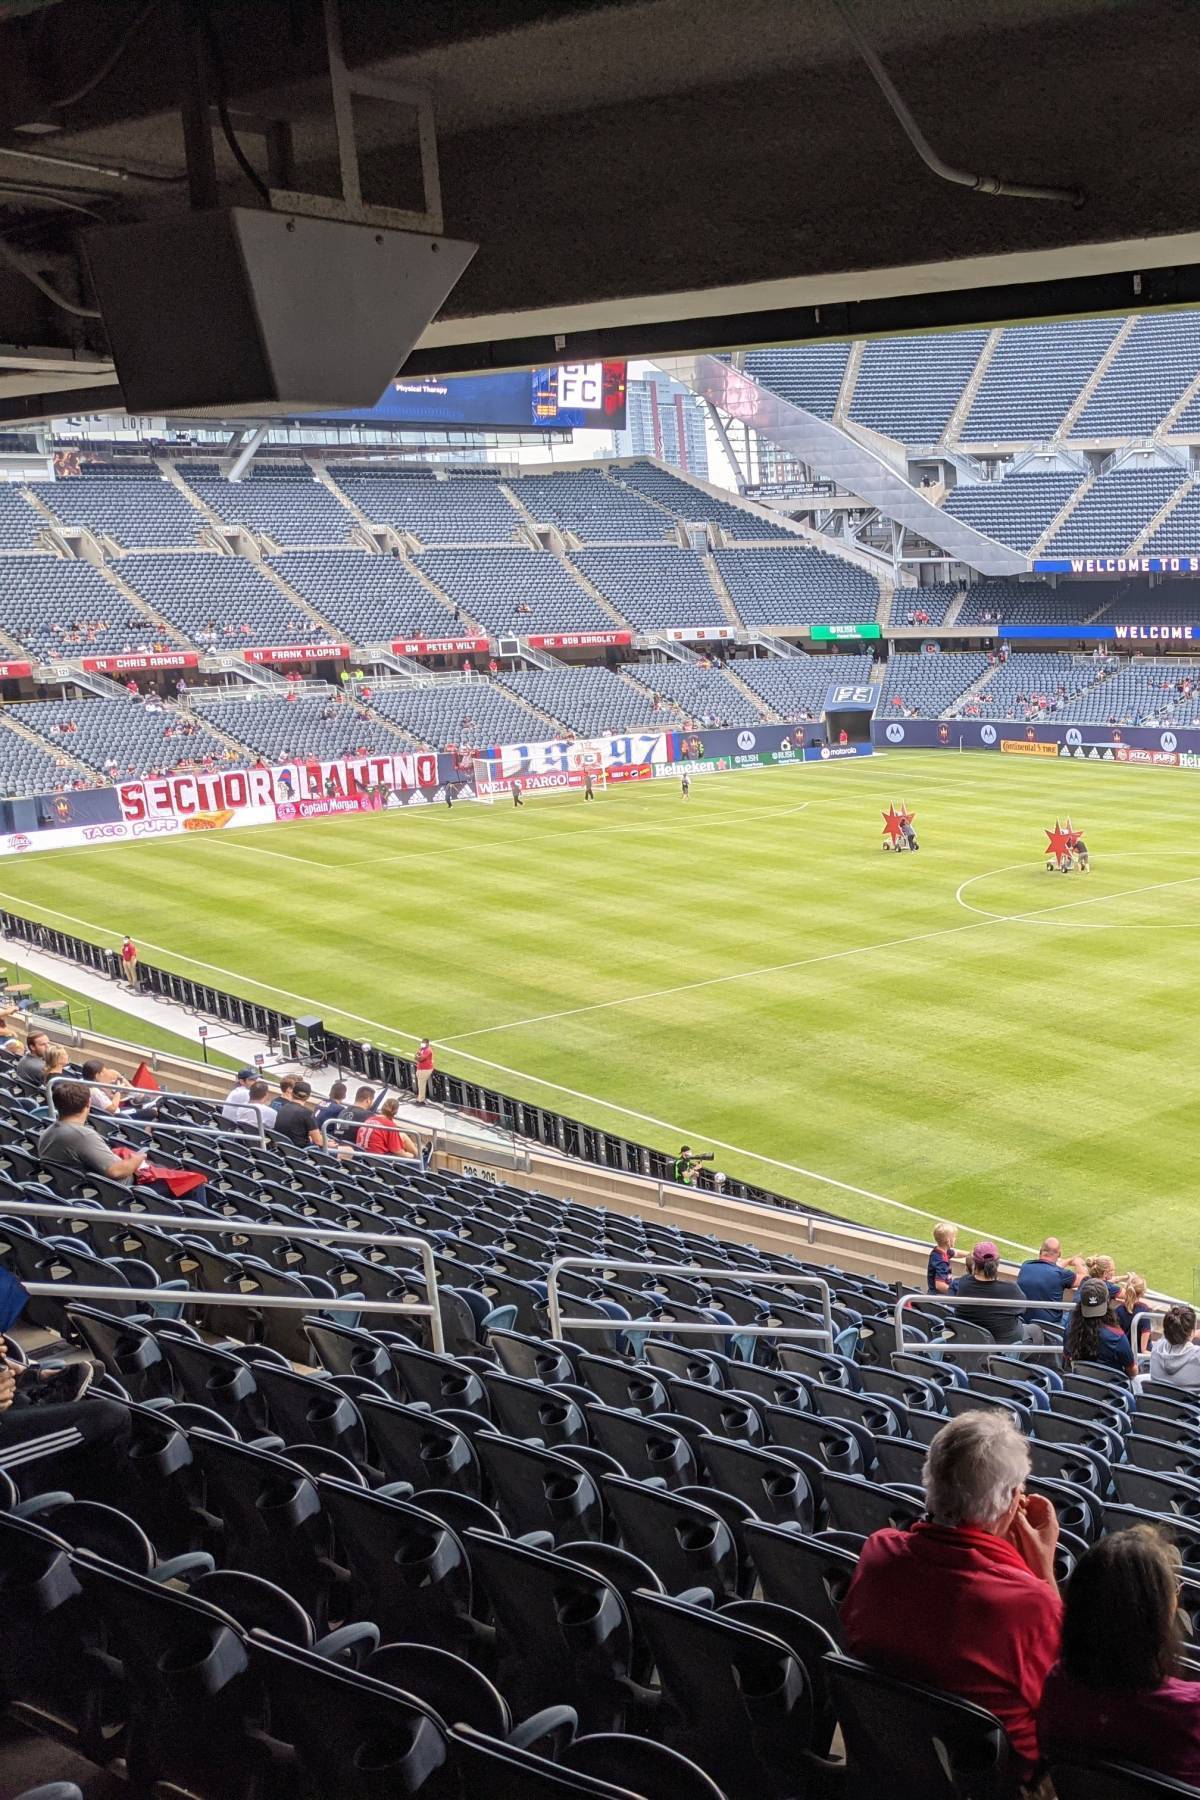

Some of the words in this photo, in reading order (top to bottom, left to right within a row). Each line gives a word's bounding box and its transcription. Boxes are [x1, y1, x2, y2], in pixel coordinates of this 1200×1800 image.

[423, 385, 448, 395] Therapy
[563, 379, 597, 402] FC
[122, 417, 153, 430] LOFT
[1071, 559, 1150, 572] WELCOME
[1160, 558, 1179, 571] TO
[1115, 626, 1192, 639] WELCOME
[405, 644, 419, 653] GM
[426, 642, 454, 651] PETER
[456, 641, 476, 650] WILT
[543, 637, 555, 645] HC
[562, 637, 578, 645] BOB
[580, 635, 617, 644] BRADLEY
[253, 652, 264, 661] 41
[271, 649, 303, 660] FRANK
[306, 647, 342, 658] KLOPAS
[96, 660, 107, 670] 14
[116, 658, 147, 668] CHRIS
[150, 656, 185, 666] ARMAS
[830, 747, 857, 757] motorola
[1002, 740, 1036, 752] Continental
[740, 754, 759, 763] RUSH
[777, 751, 796, 759] RUSH
[1129, 750, 1151, 761] PIZZA
[1152, 752, 1177, 764] PUFF
[655, 760, 715, 777] Heineken
[121, 768, 273, 822] SECTOR
[300, 753, 438, 800] LATINO
[479, 779, 522, 794] WELLS
[526, 774, 567, 789] FARGO
[299, 800, 328, 817] Captain
[327, 798, 359, 813] Morgan
[83, 824, 127, 840] TACO
[132, 819, 179, 836] PUFF
